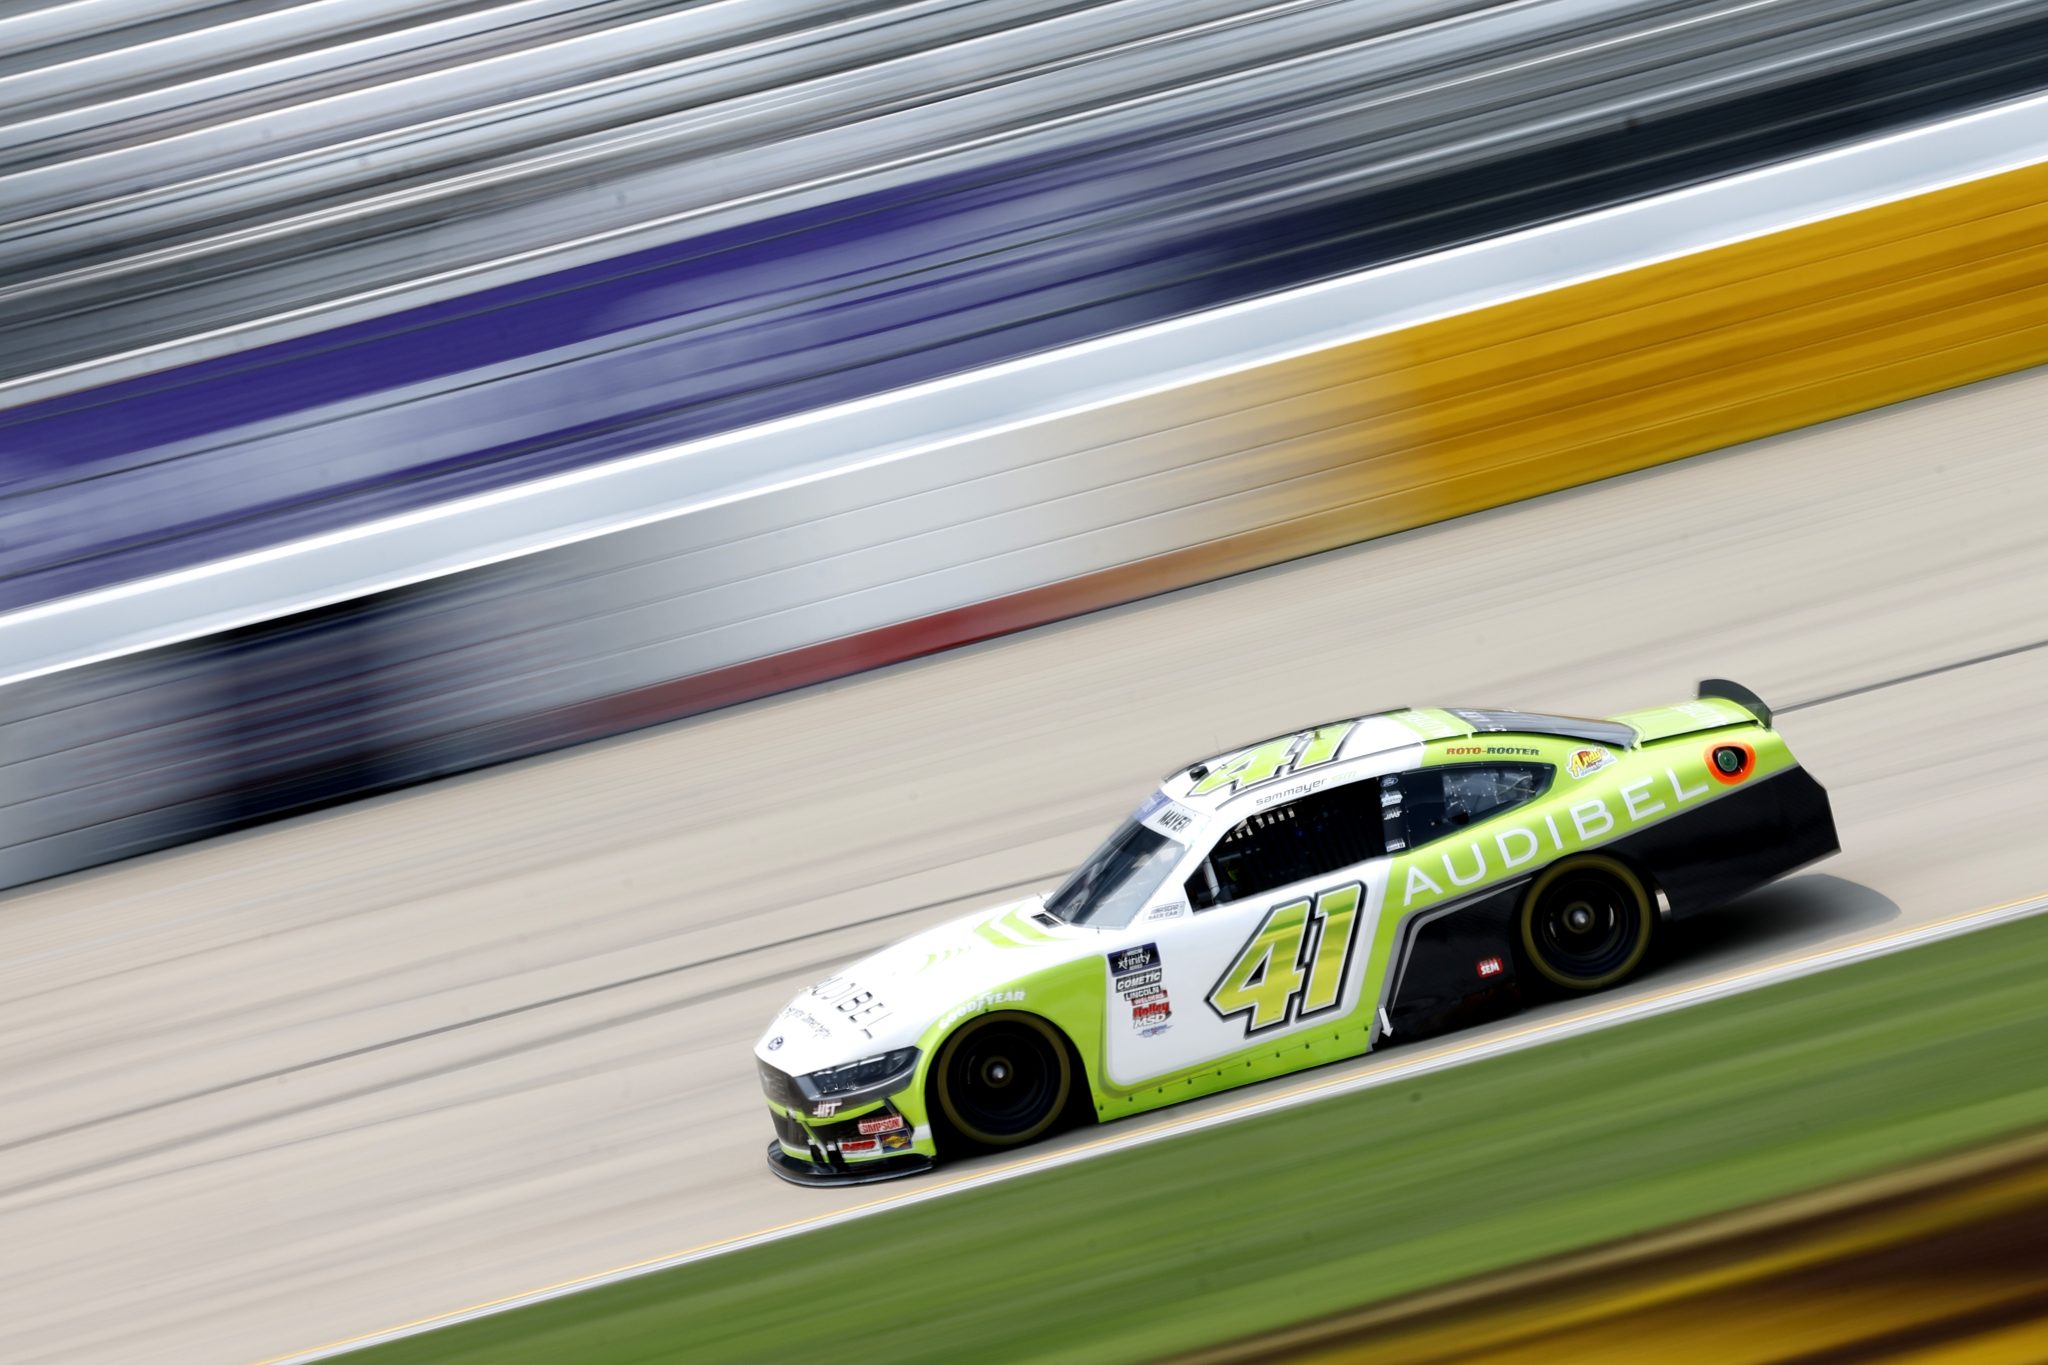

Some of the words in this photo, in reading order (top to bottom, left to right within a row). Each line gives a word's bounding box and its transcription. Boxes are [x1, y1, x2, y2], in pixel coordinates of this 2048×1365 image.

[1186, 719, 1362, 798] 41
[1446, 746, 1540, 756] ROTO-ROOTER
[1157, 809, 1193, 834] MAYER
[1402, 767, 1709, 906] AUDIBEL
[1117, 951, 1151, 970] xfinity
[1204, 880, 1367, 1039] 41
[1117, 972, 1161, 990] COMETIC
[862, 1118, 900, 1134] SIMPSON
